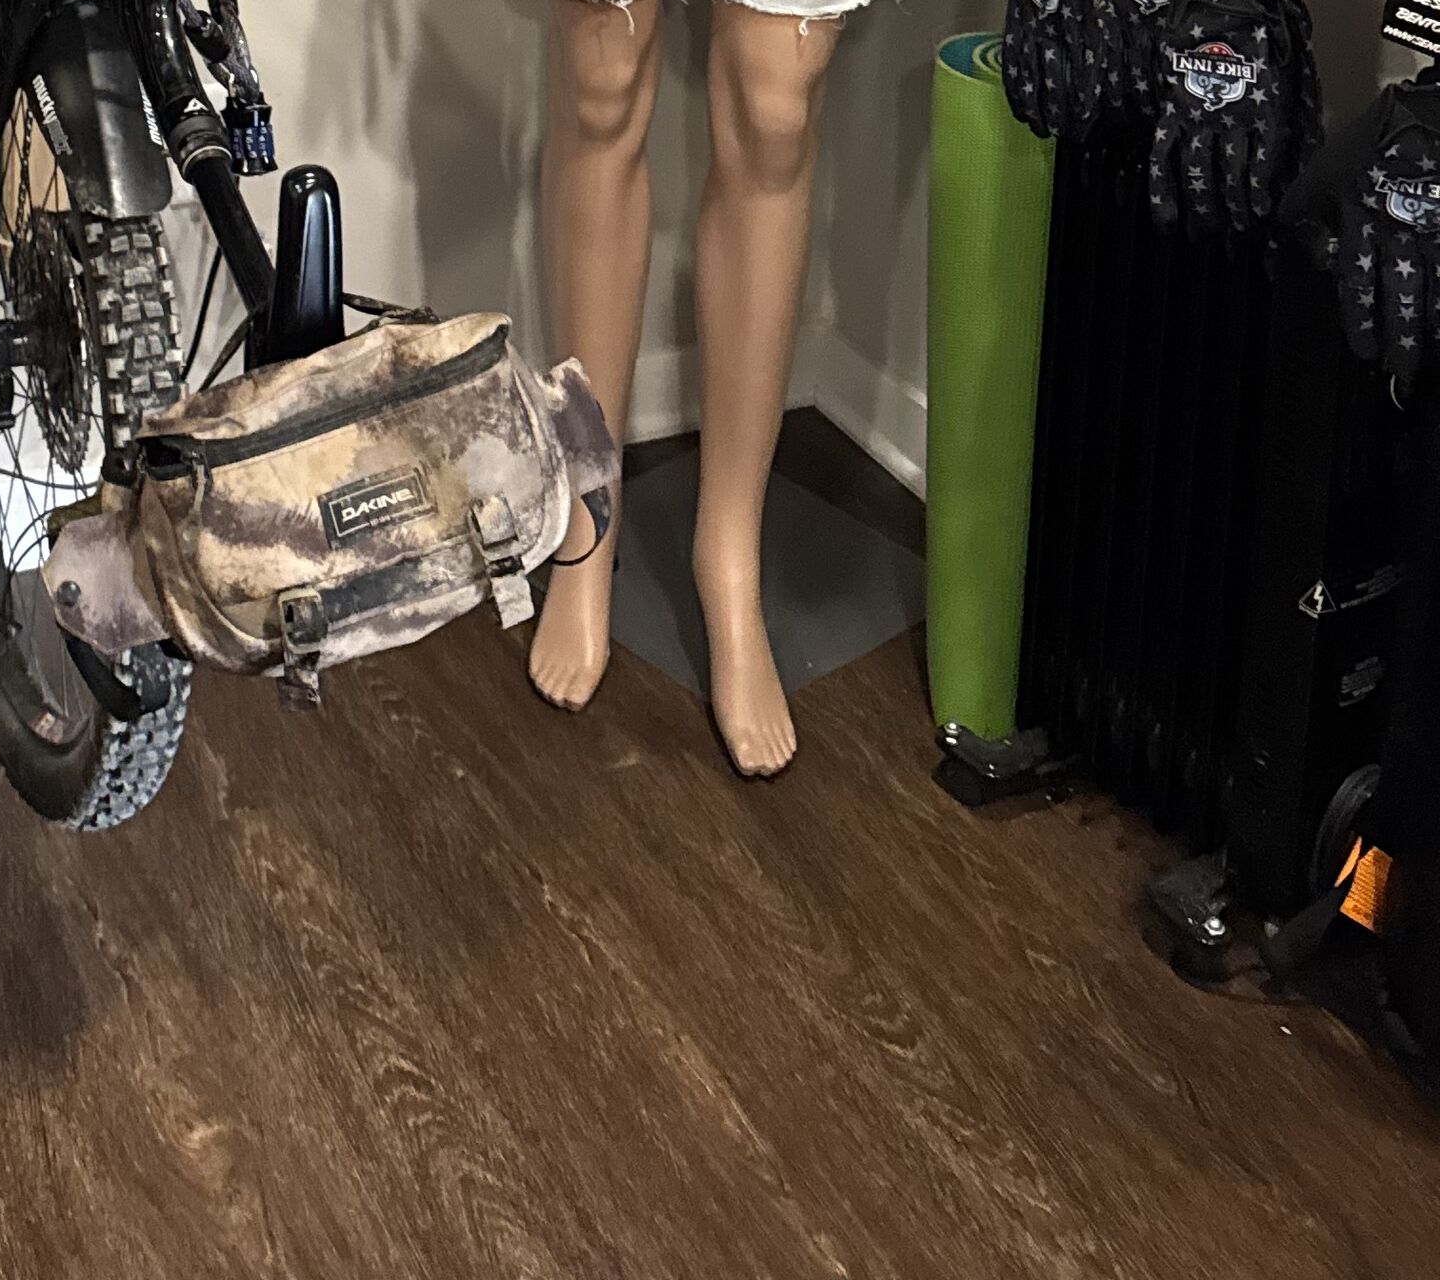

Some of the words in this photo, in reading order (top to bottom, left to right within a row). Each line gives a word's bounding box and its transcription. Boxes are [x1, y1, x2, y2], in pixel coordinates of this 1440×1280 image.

[1179, 56, 1213, 75] INN
[1215, 60, 1252, 80] BIKE
[340, 487, 415, 522] DAKINE
